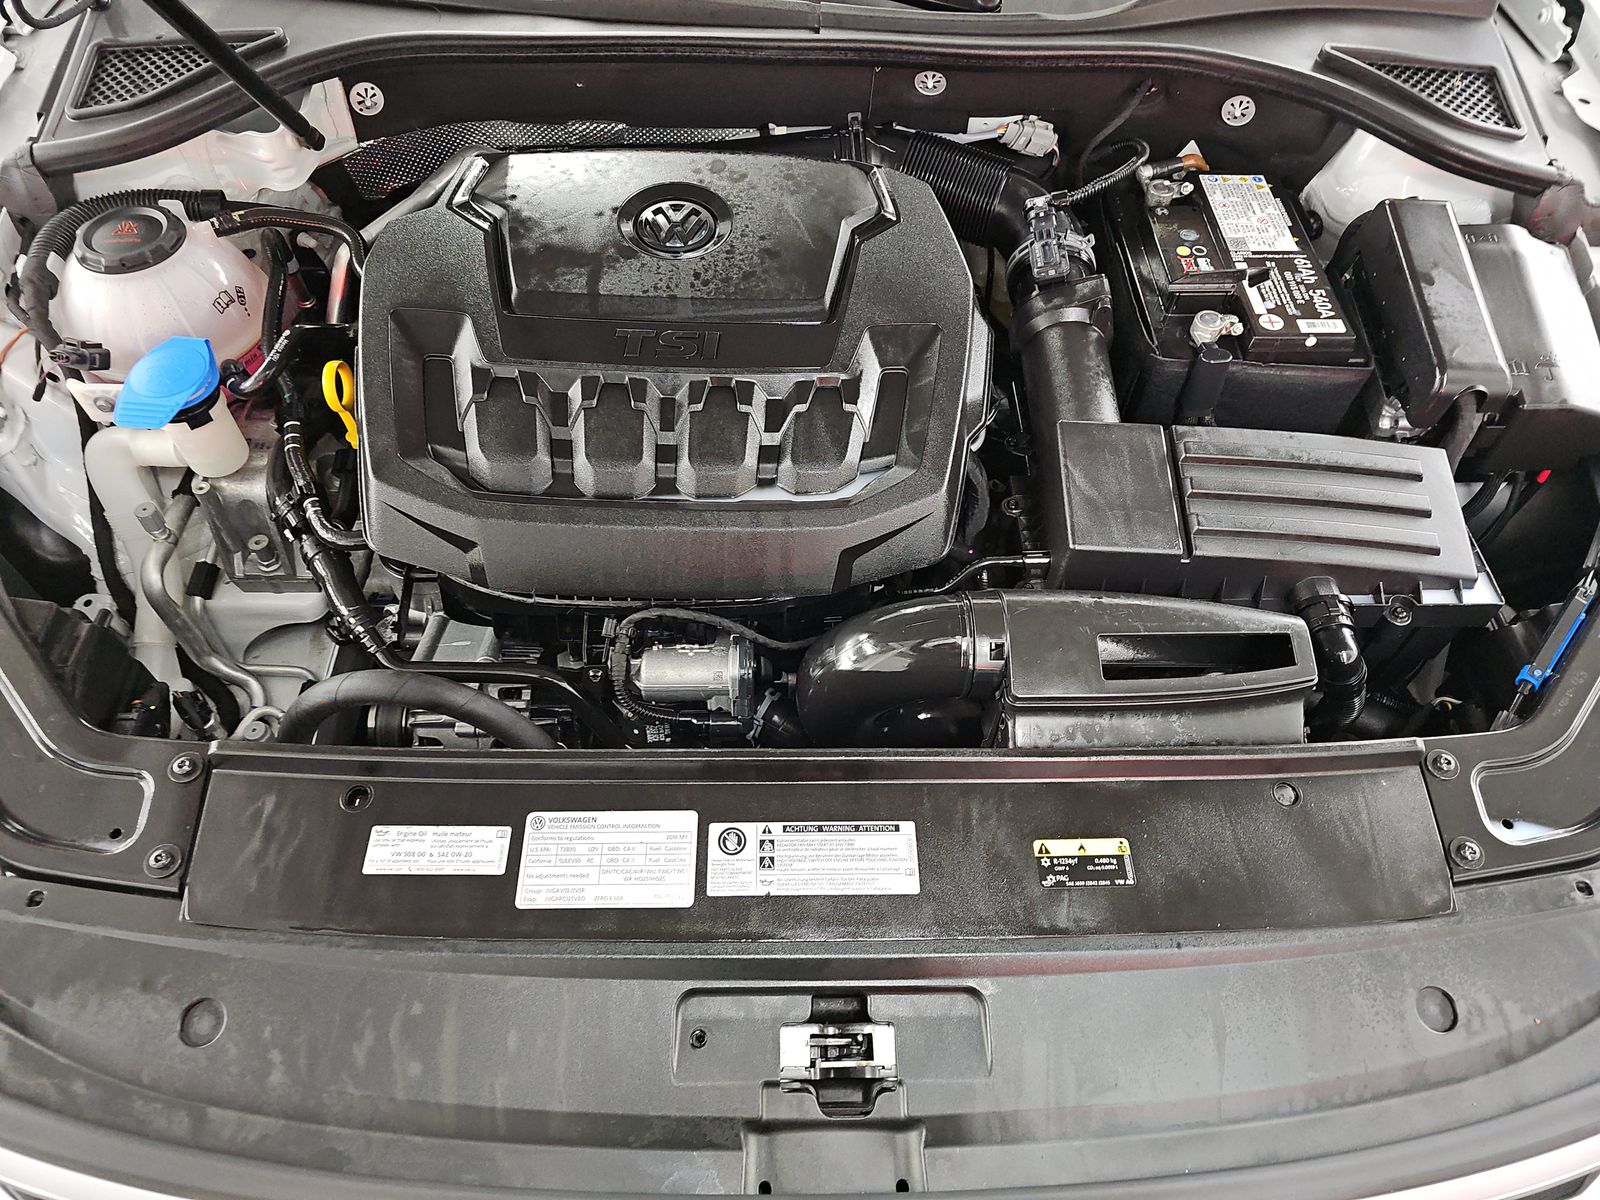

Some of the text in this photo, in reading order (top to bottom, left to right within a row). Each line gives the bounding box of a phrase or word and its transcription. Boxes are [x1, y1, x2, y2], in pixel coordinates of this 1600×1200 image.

[636, 198, 716, 252] VW
[1294, 258, 1336, 318] 61Ah 540A
[615, 327, 721, 361] TSI
[548, 816, 598, 824] VOLKSWAGEN
[396, 830, 417, 838] Engine
[1053, 857, 1078, 866] R-1234yf
